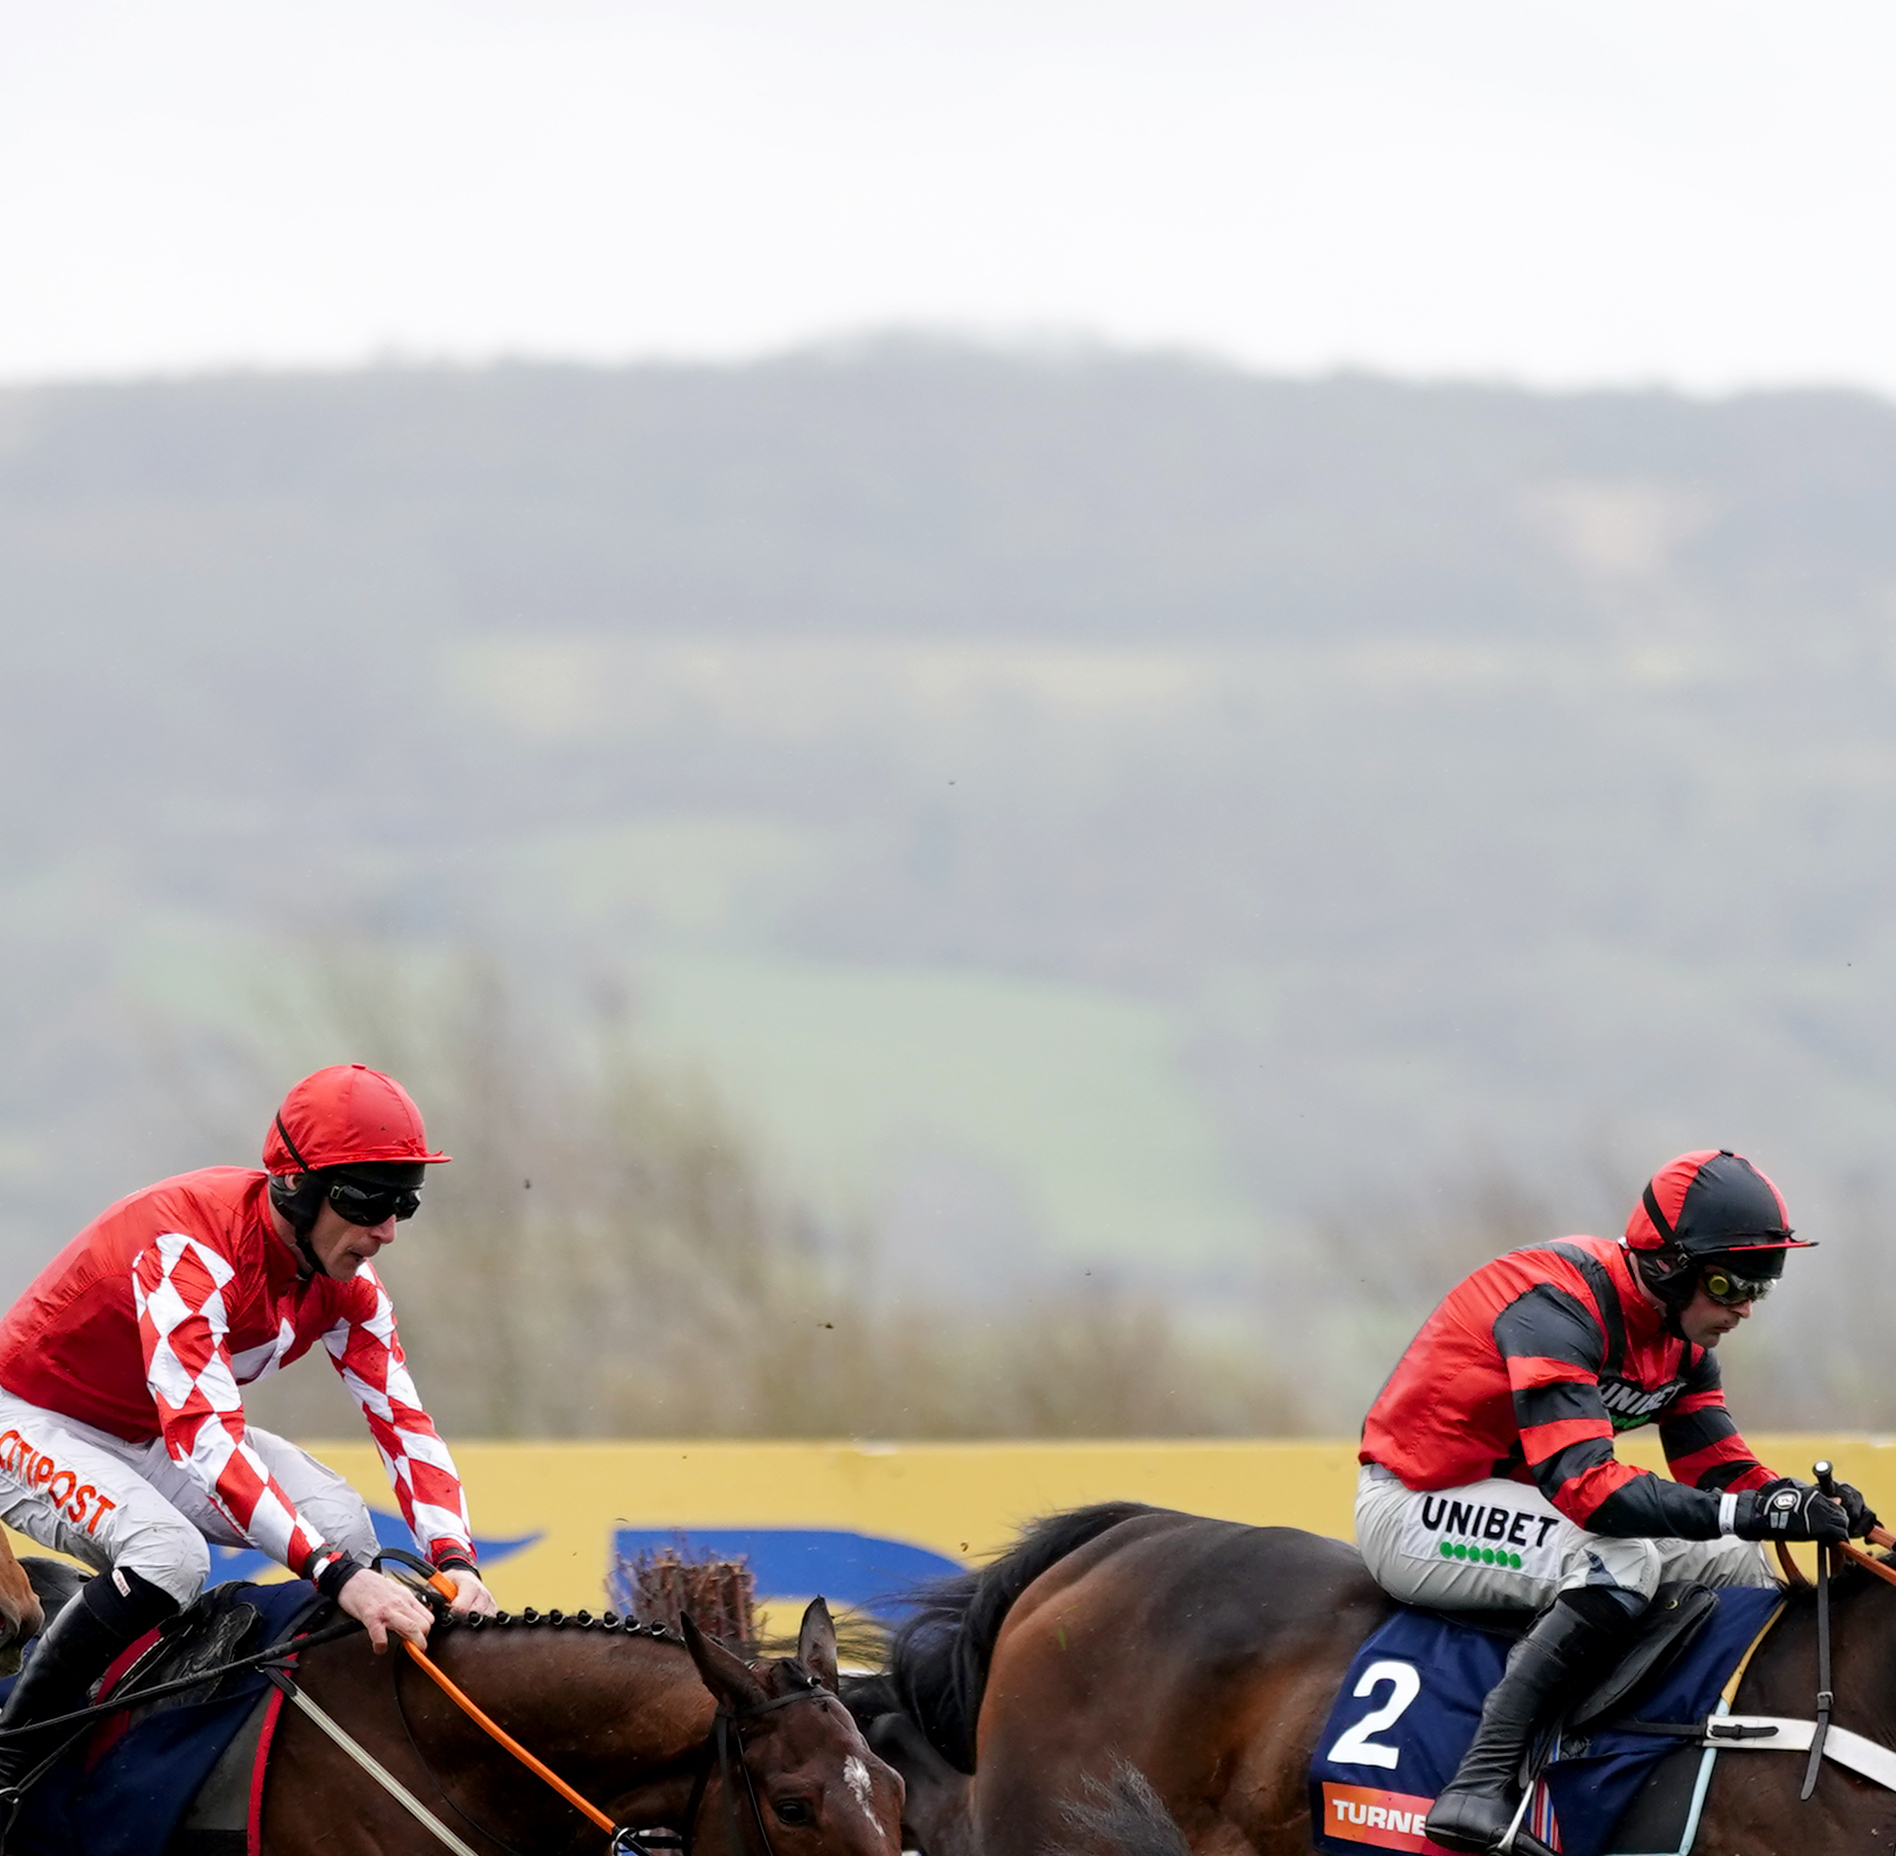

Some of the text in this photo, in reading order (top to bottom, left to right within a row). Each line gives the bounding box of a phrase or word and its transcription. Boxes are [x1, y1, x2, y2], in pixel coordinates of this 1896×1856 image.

[1421, 1495, 1560, 1548] UNIBET
[1327, 1661, 1421, 1770] 2
[1332, 1799, 1427, 1837] TURNE
